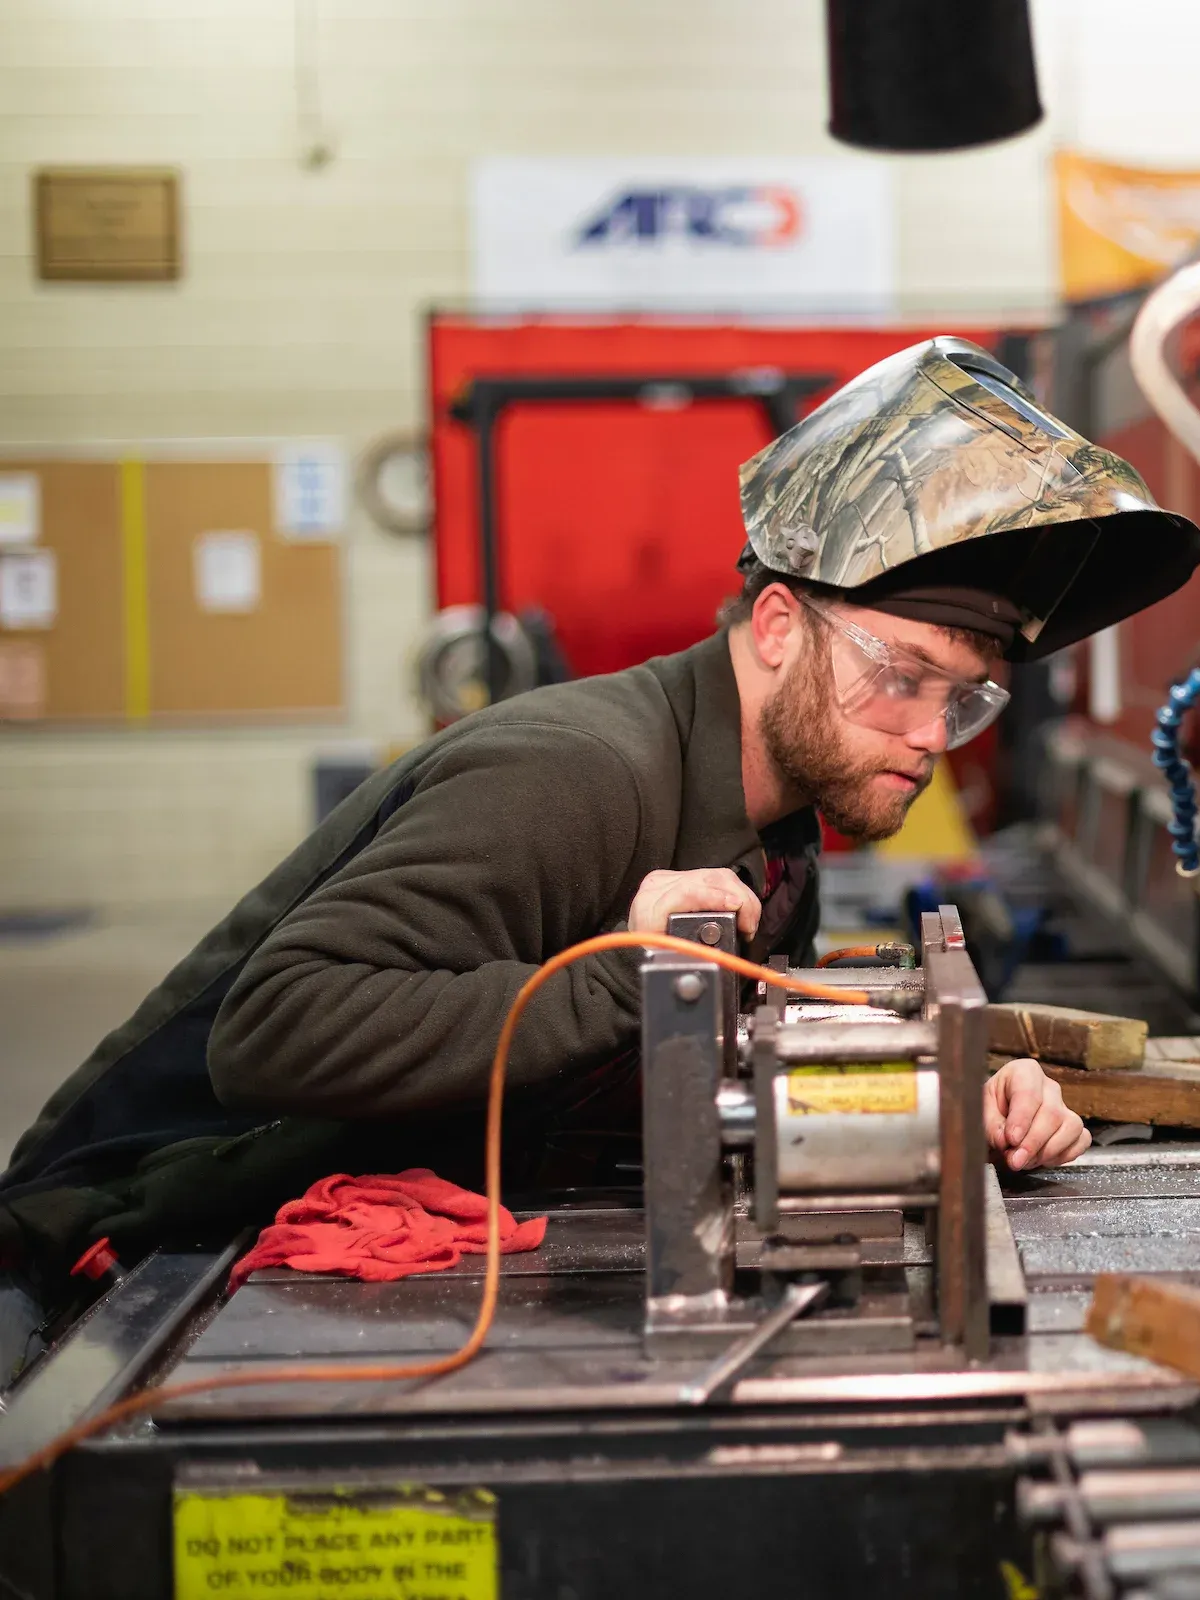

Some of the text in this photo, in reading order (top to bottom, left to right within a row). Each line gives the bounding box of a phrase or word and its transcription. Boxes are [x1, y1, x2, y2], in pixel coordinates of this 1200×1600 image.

[186, 1527, 489, 1557] DO NOT PLACE ANY PART
[206, 1561, 468, 1589] OF YOUR BODY IN THE
